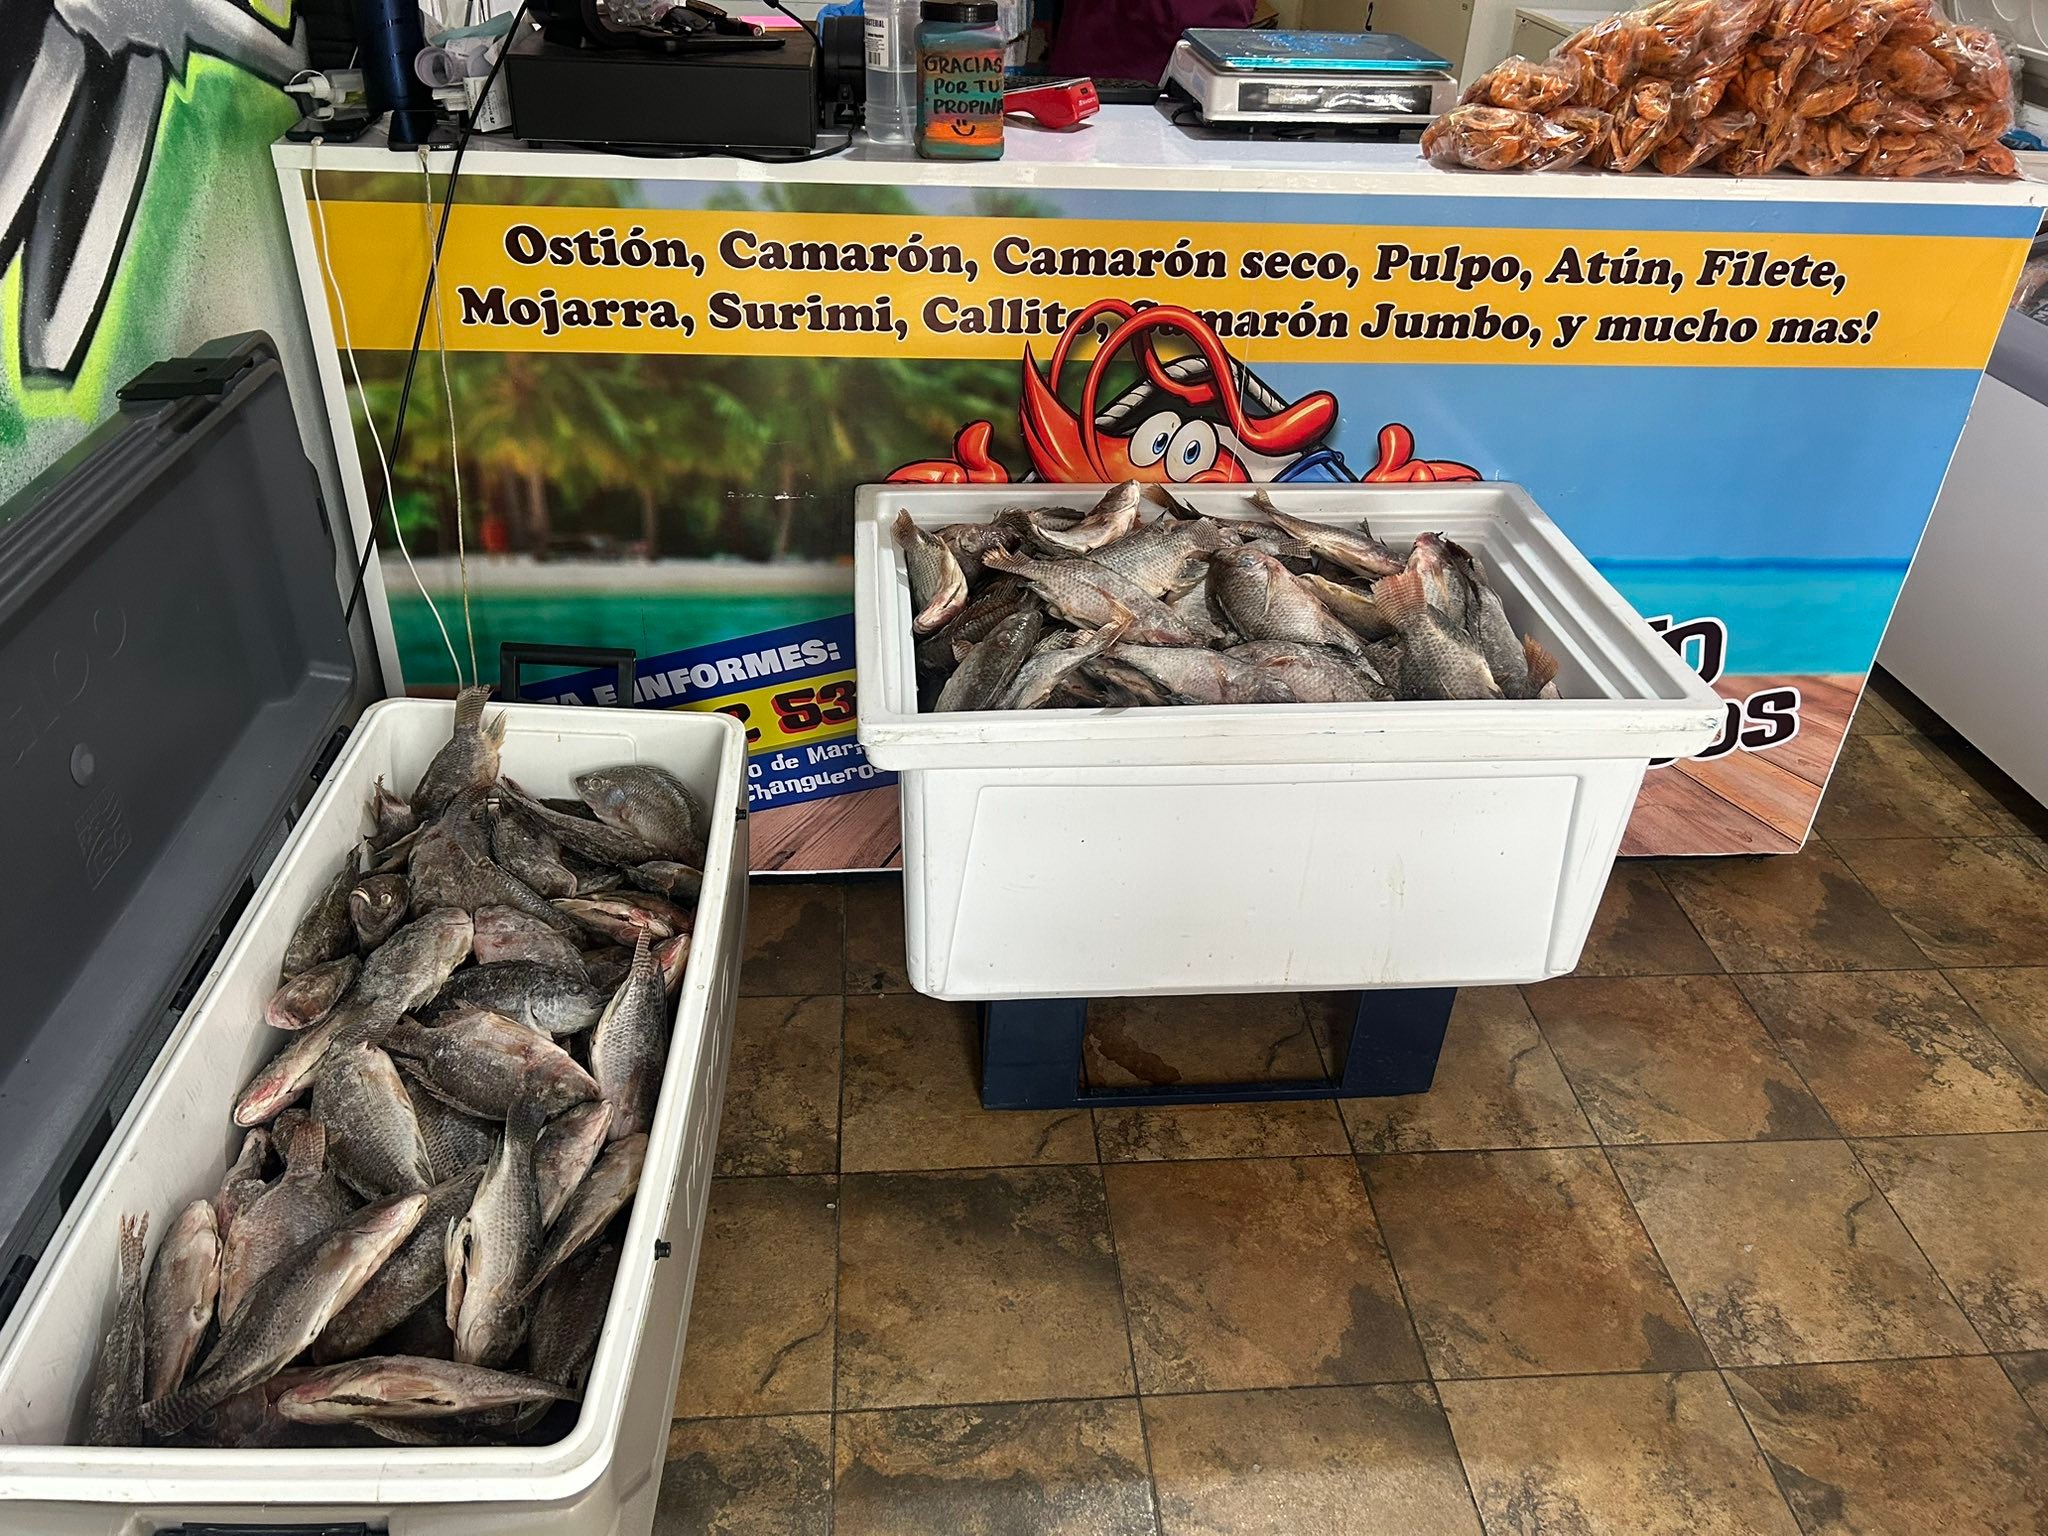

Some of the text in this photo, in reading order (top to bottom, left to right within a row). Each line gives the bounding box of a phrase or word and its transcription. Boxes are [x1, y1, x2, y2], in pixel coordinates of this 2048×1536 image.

[924, 55, 1003, 74] GRACIAS
[934, 78, 1000, 95] POR TU
[505, 225, 1846, 296] Ostión, Camarón, Camarón seco, Pulpo, Atún, Filete,
[458, 286, 695, 338] Mojarra,
[708, 291, 908, 341] Surimi,
[1361, 302, 1543, 349] Jumbo,
[1553, 313, 1586, 348] y
[1595, 308, 1757, 343] mucho
[1766, 310, 1879, 344] mas!
[771, 753, 800, 771] de
[807, 743, 866, 765] Mari
